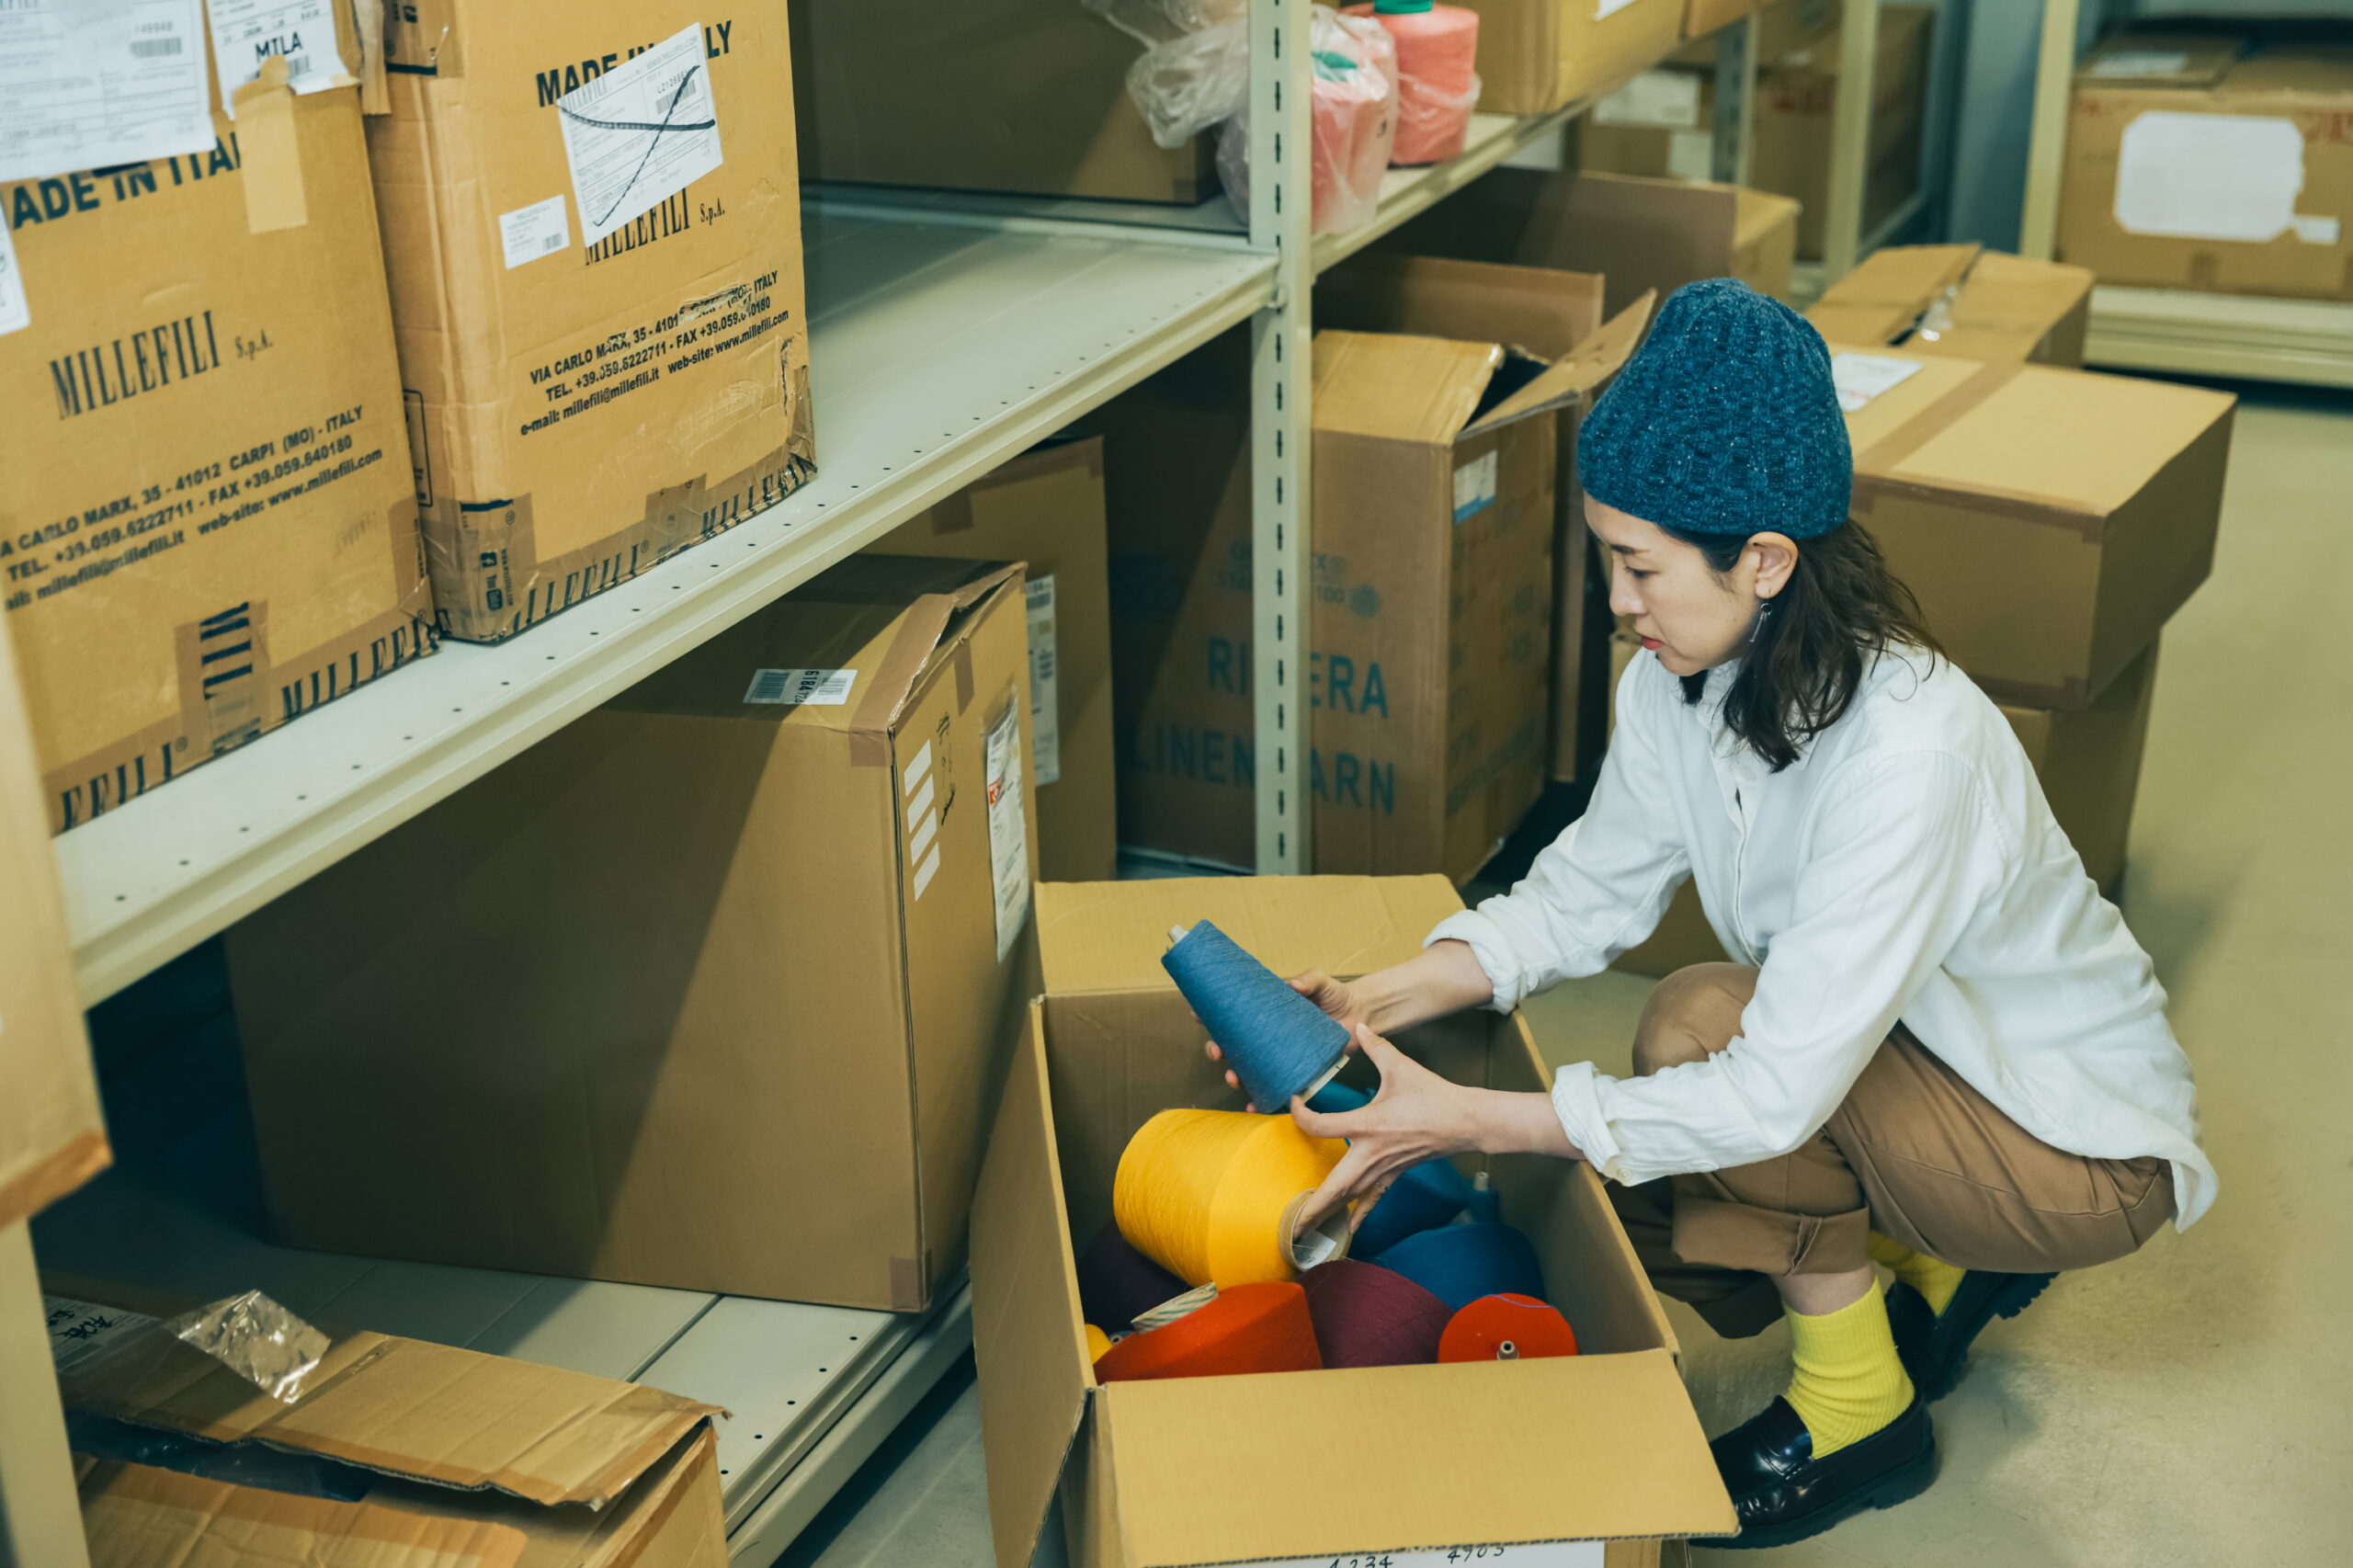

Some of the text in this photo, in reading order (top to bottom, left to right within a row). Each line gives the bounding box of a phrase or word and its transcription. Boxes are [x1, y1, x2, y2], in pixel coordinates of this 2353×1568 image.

[50, 310, 222, 421] MILLEFILI
[529, 366, 551, 384] VIA
[554, 349, 594, 375] CARLO
[633, 326, 647, 344] 35
[754, 270, 778, 294] ITALY
[546, 382, 573, 402] TEL.
[676, 328, 698, 348] FAX
[563, 368, 660, 419] millefili@millefili.it
[667, 347, 714, 374] web-site:
[715, 311, 789, 354] www.millefili.com
[17, 517, 79, 550] CARLO
[142, 484, 162, 505] 35
[176, 462, 222, 491] 41012
[230, 441, 275, 471] CARPI
[283, 426, 314, 453] (MO)
[325, 404, 363, 433] ITALY
[267, 449, 382, 506] www.millefili.com
[6, 559, 50, 582] TEL.
[209, 481, 240, 506] FAX
